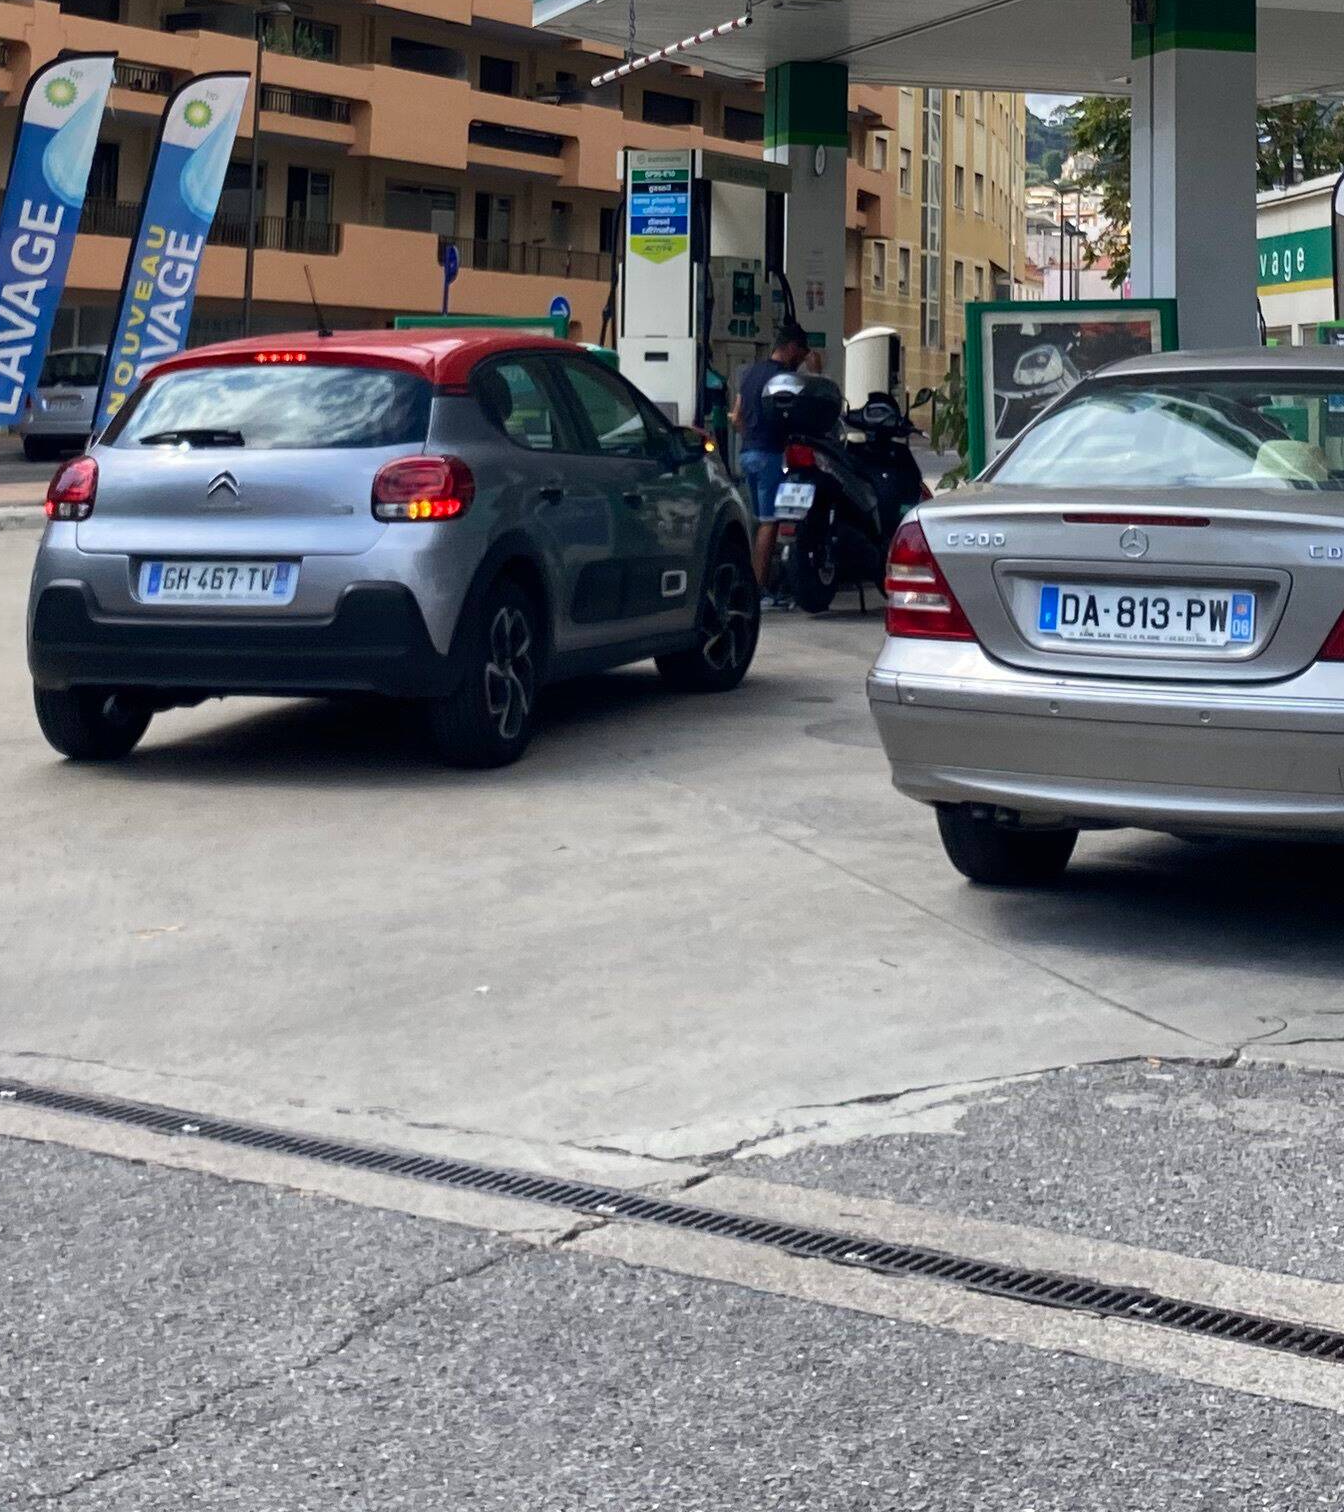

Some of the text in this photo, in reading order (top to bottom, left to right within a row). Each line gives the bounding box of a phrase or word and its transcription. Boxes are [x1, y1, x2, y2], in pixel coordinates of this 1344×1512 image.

[1259, 246, 1305, 282] vage
[107, 224, 167, 415] NOUVEAU
[134, 230, 204, 382] VAGE
[947, 532, 1006, 547] C 200
[1060, 593, 1229, 633] DA-813-PW
[1231, 618, 1250, 637] 06
